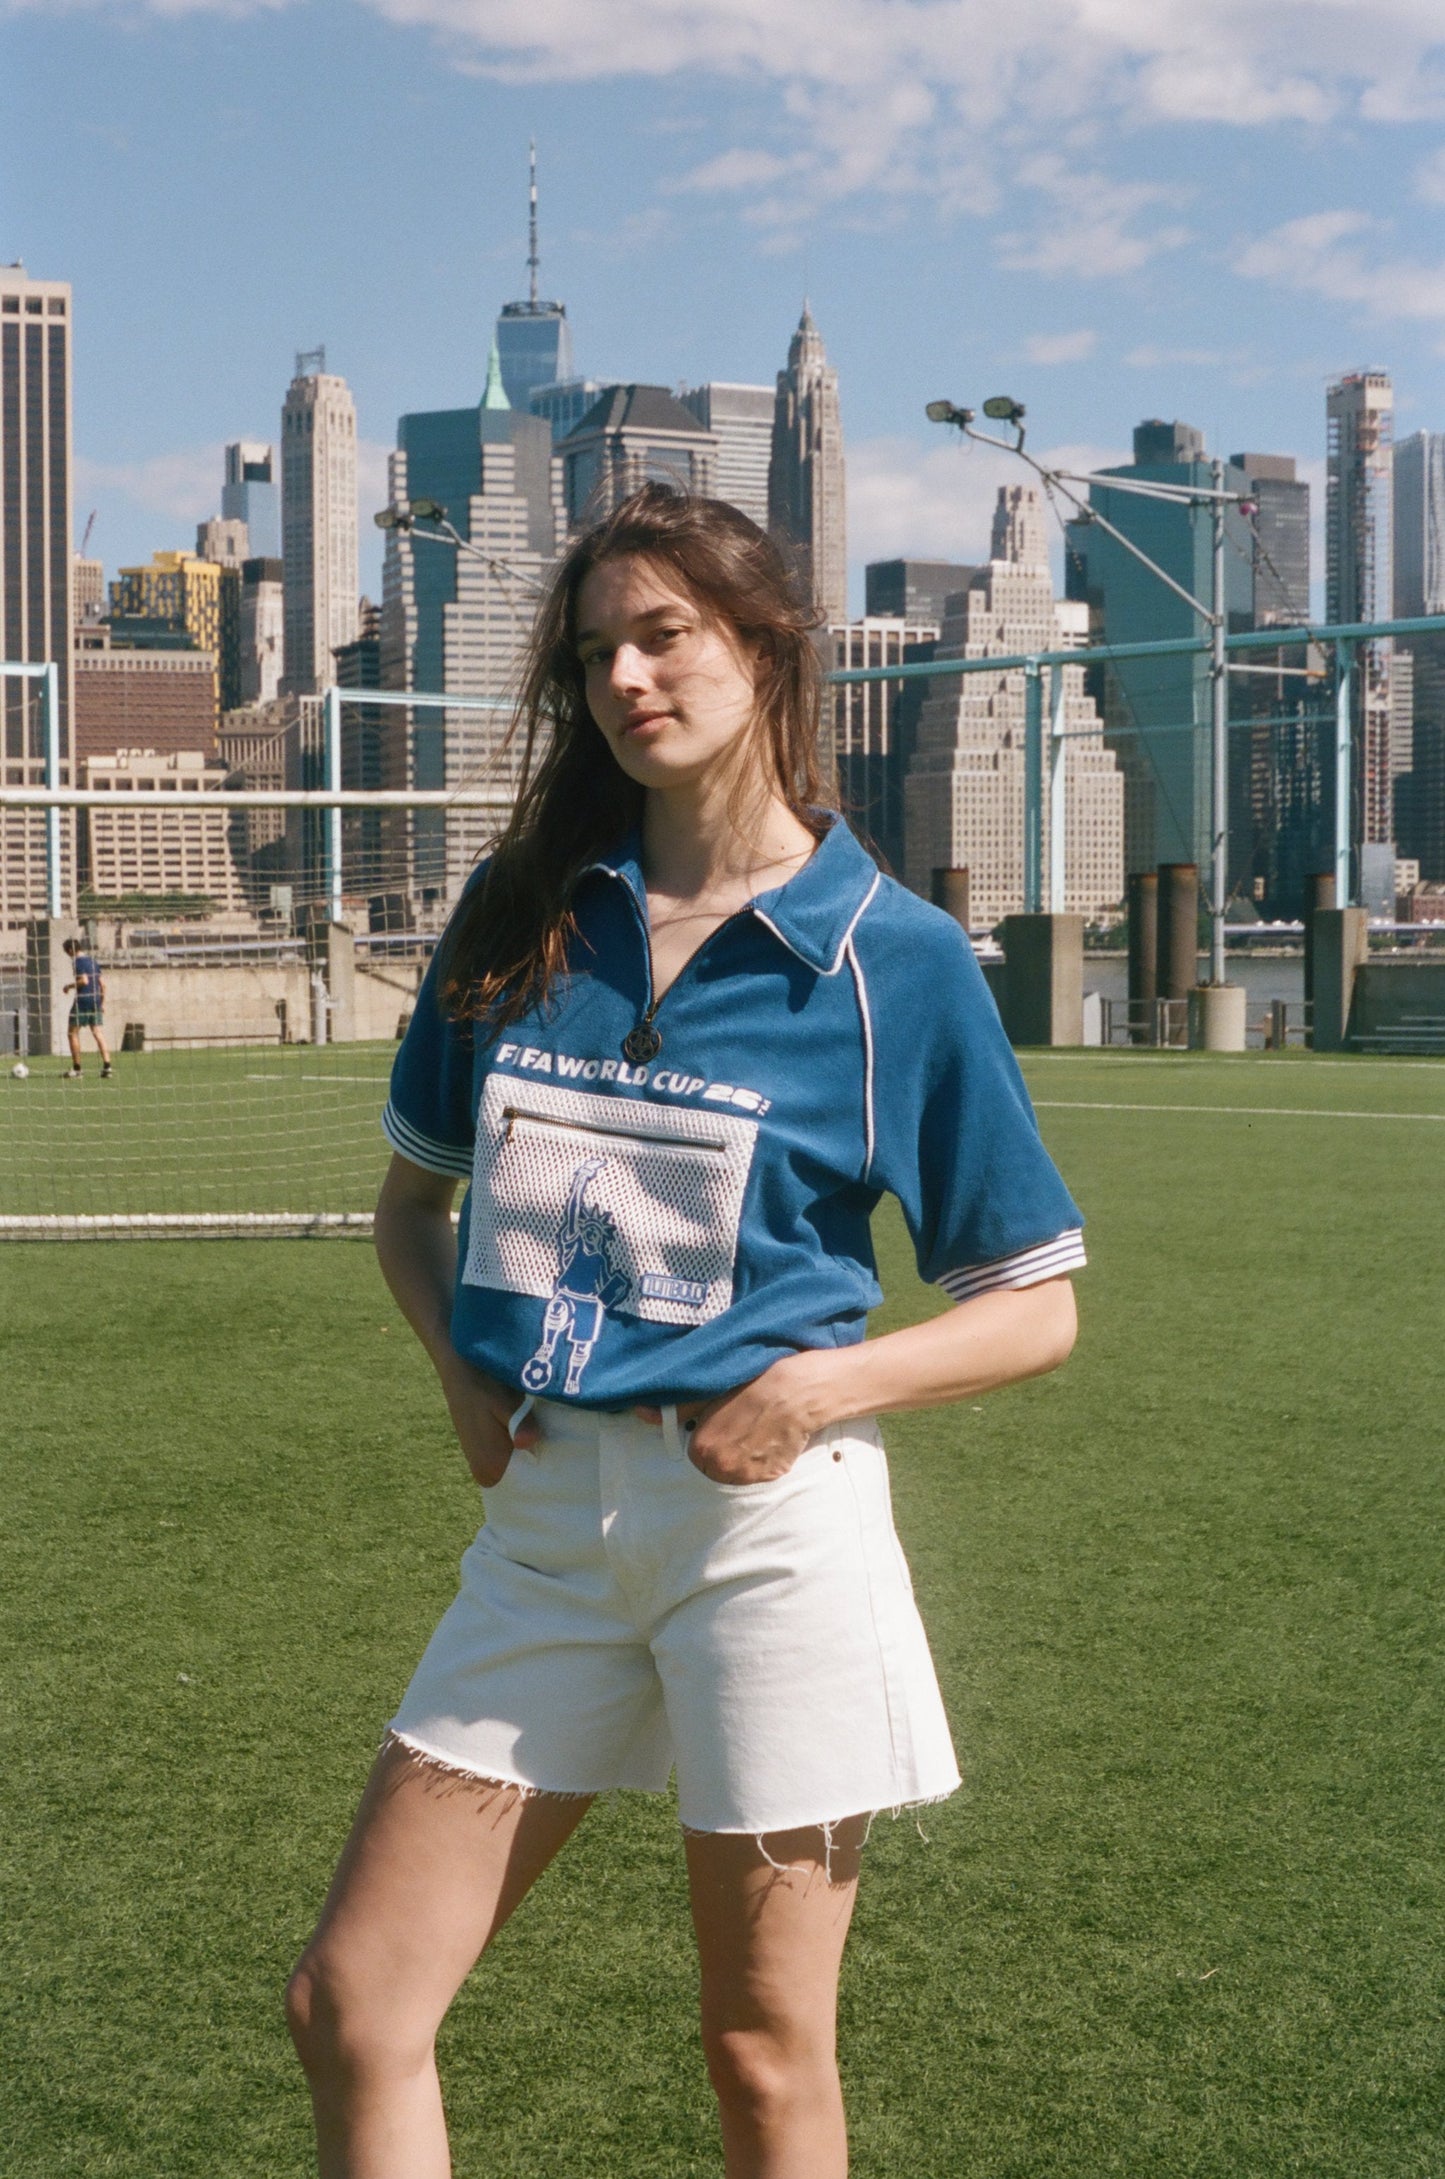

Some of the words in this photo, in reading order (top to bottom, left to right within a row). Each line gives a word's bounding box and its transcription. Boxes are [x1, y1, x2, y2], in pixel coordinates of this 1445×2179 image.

[496, 1043, 552, 1073] FIFA
[556, 1054, 650, 1087] WORLD
[652, 1070, 705, 1095] CUP
[702, 1083, 762, 1110] 26
